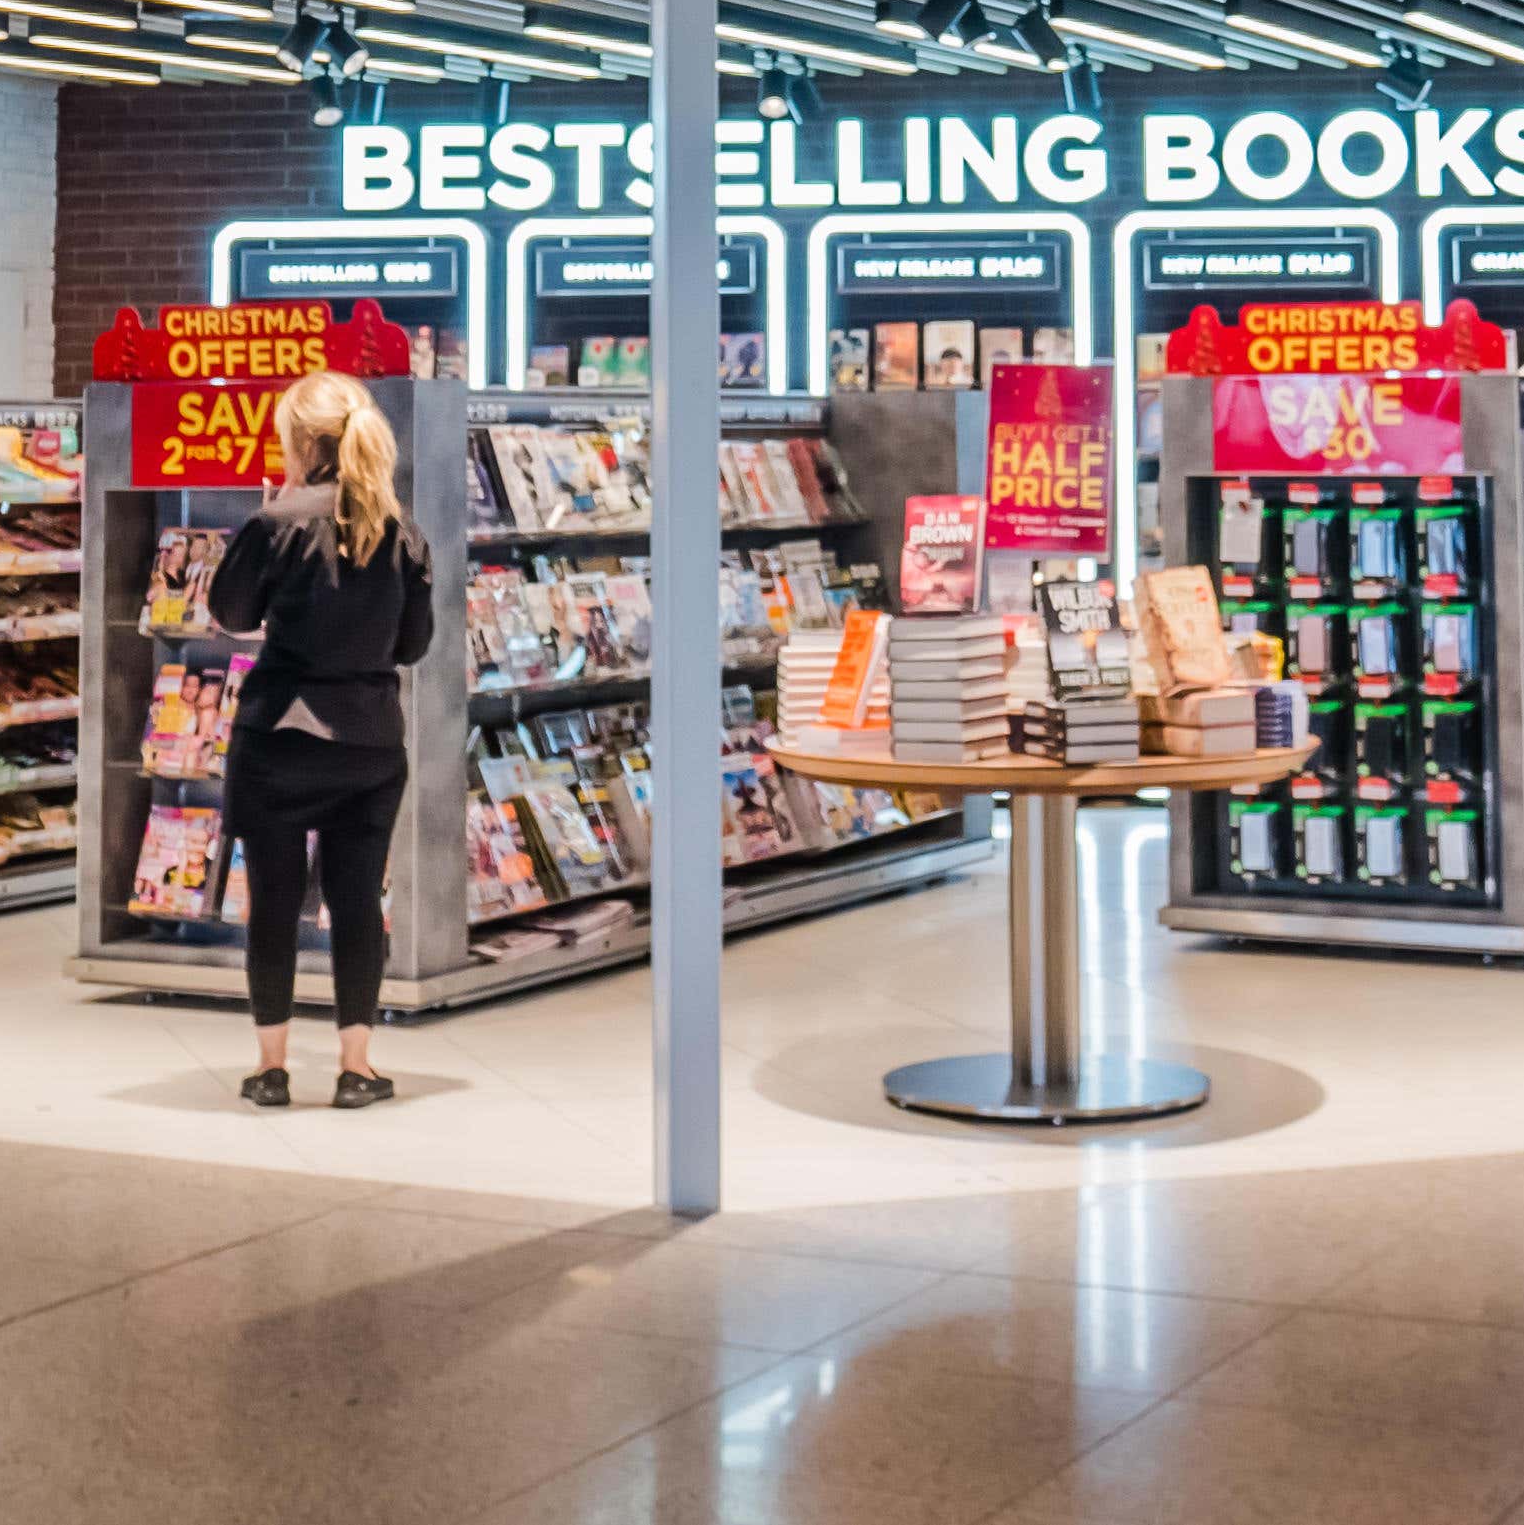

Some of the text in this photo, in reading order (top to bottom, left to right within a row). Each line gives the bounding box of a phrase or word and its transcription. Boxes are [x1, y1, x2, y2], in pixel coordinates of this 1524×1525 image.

[165, 306, 327, 337] CHRISTMAS
[1246, 307, 1417, 334] CHRISTMAS
[168, 338, 329, 378] OFFERS
[1248, 335, 1419, 372] OFFERS
[1271, 383, 1403, 426] SAVE
[161, 436, 185, 475] 2
[993, 442, 1107, 475] HALF
[991, 477, 1104, 510] PRICE
